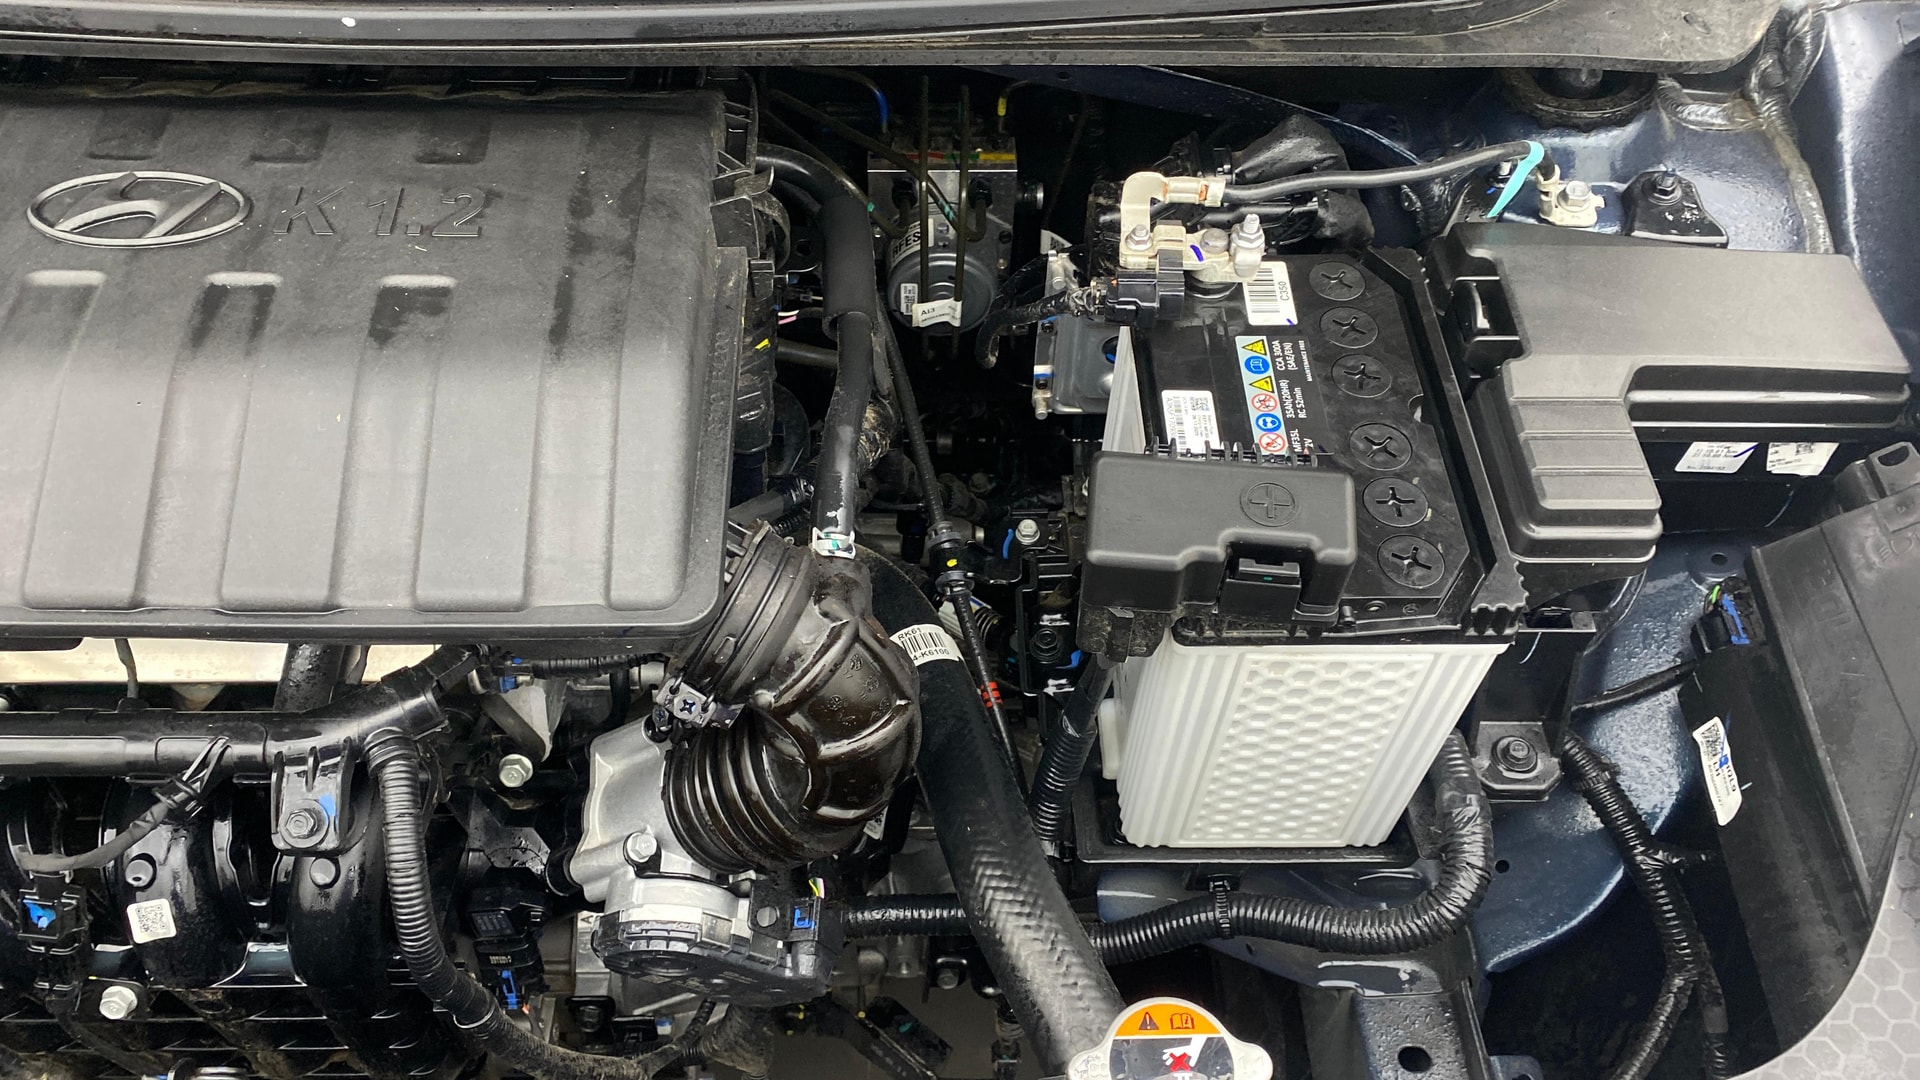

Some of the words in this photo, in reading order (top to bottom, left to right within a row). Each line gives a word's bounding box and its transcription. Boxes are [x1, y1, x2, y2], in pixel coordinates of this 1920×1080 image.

[273, 186, 346, 235] K
[368, 187, 486, 237] 1.2
[1278, 281, 1290, 301] C350
[1275, 357, 1286, 371] CCA
[1293, 387, 1305, 408] 52min
[1298, 409, 1307, 419] RC
[898, 627, 922, 641] RK61
